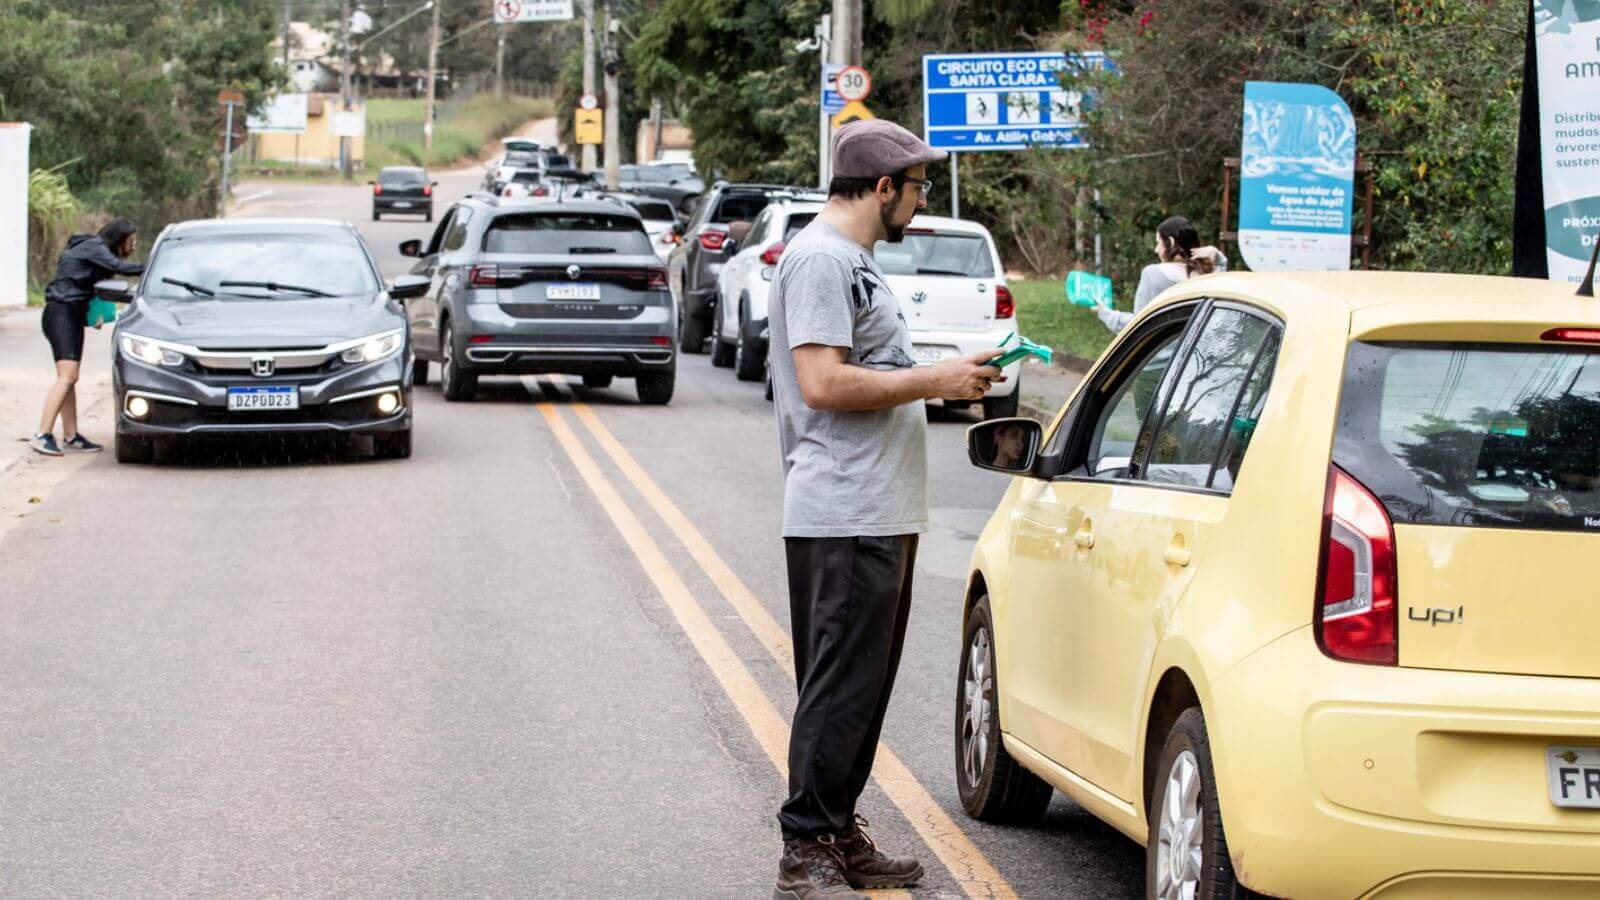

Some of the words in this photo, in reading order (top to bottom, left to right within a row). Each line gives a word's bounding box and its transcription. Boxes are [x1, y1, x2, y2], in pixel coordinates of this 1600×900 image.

[937, 60, 1004, 75] CIRCUITO
[1007, 60, 1038, 73] ECO
[843, 74, 863, 88] 30
[949, 73, 997, 87] SANTA
[998, 72, 1046, 86] CLARA
[974, 131, 994, 143] Av.
[1555, 128, 1600, 138] mudas
[1563, 215, 1600, 228] PRÓX
[1584, 516, 1600, 527] No
[1408, 605, 1463, 627] up!
[1559, 767, 1600, 799] FR
